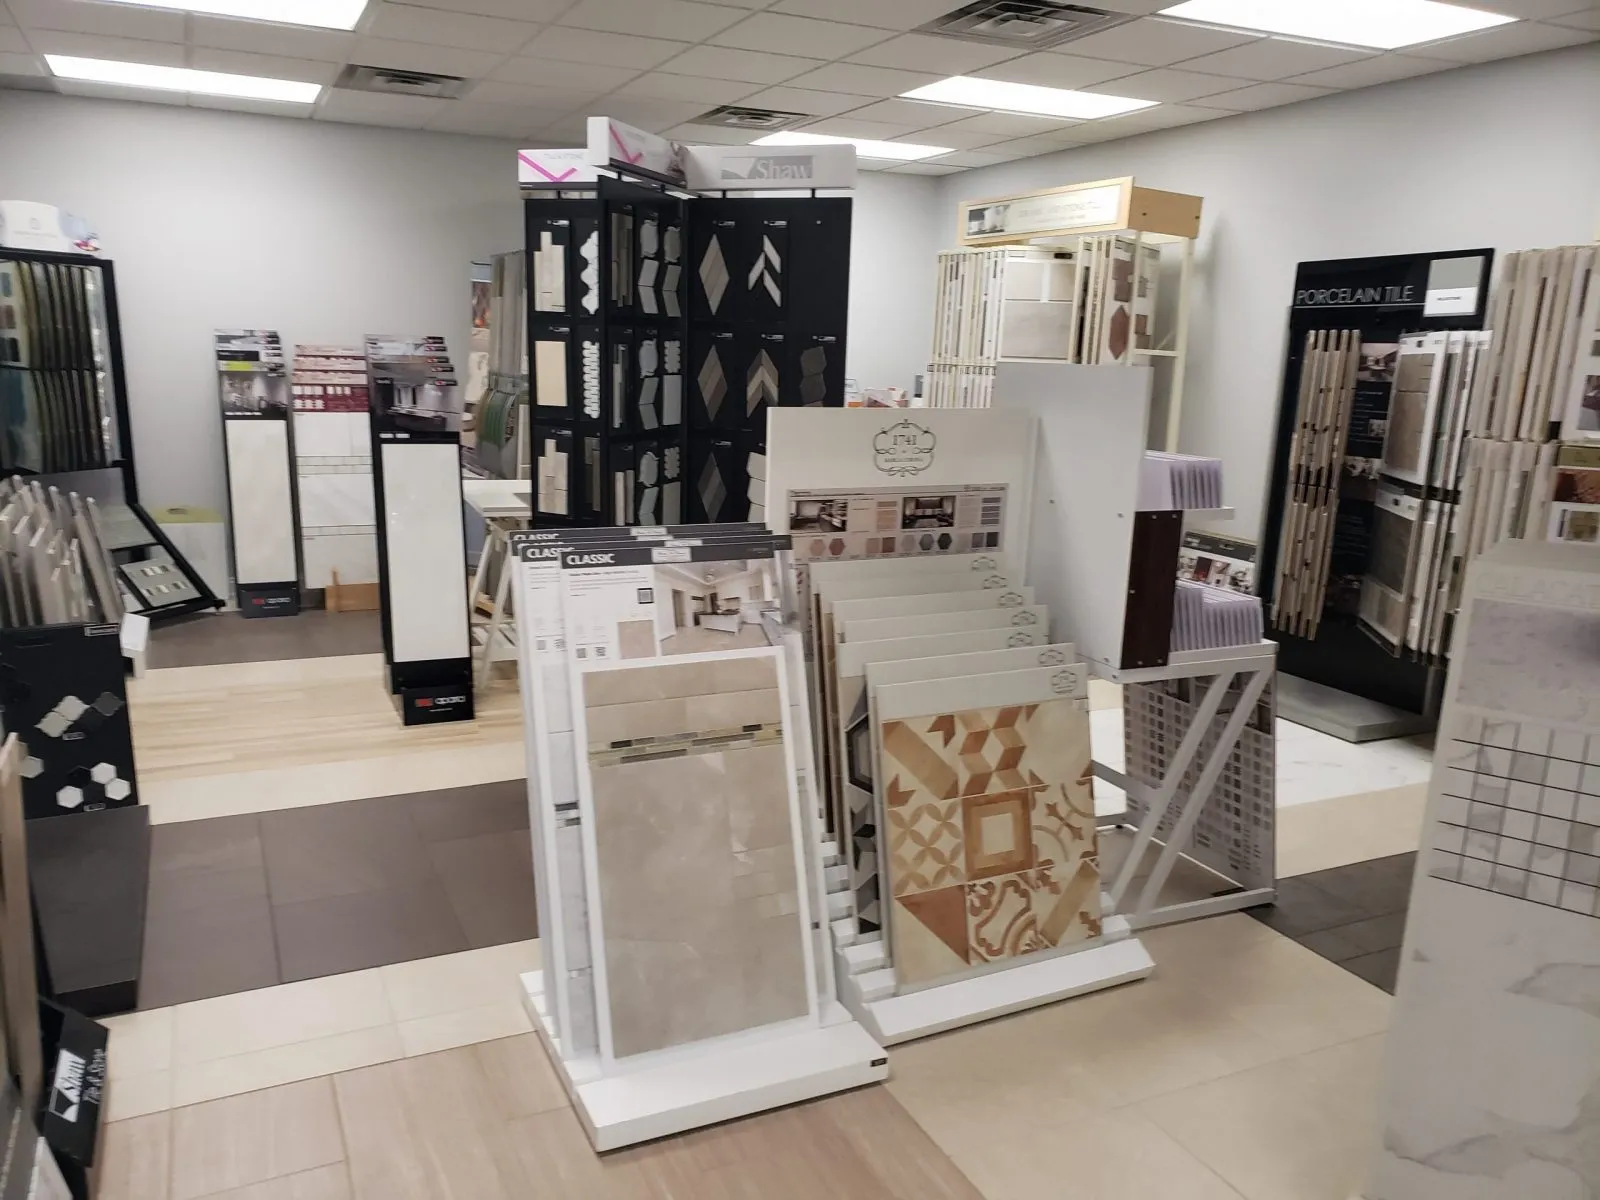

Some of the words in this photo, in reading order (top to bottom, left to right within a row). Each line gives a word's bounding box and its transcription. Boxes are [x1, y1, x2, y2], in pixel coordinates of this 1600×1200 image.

[755, 159, 813, 179] Shaw
[1295, 287, 1382, 305] PORCELAIN
[1383, 285, 1414, 302] TILE
[892, 434, 917, 446] 1741
[566, 553, 616, 565] CLASSIC
